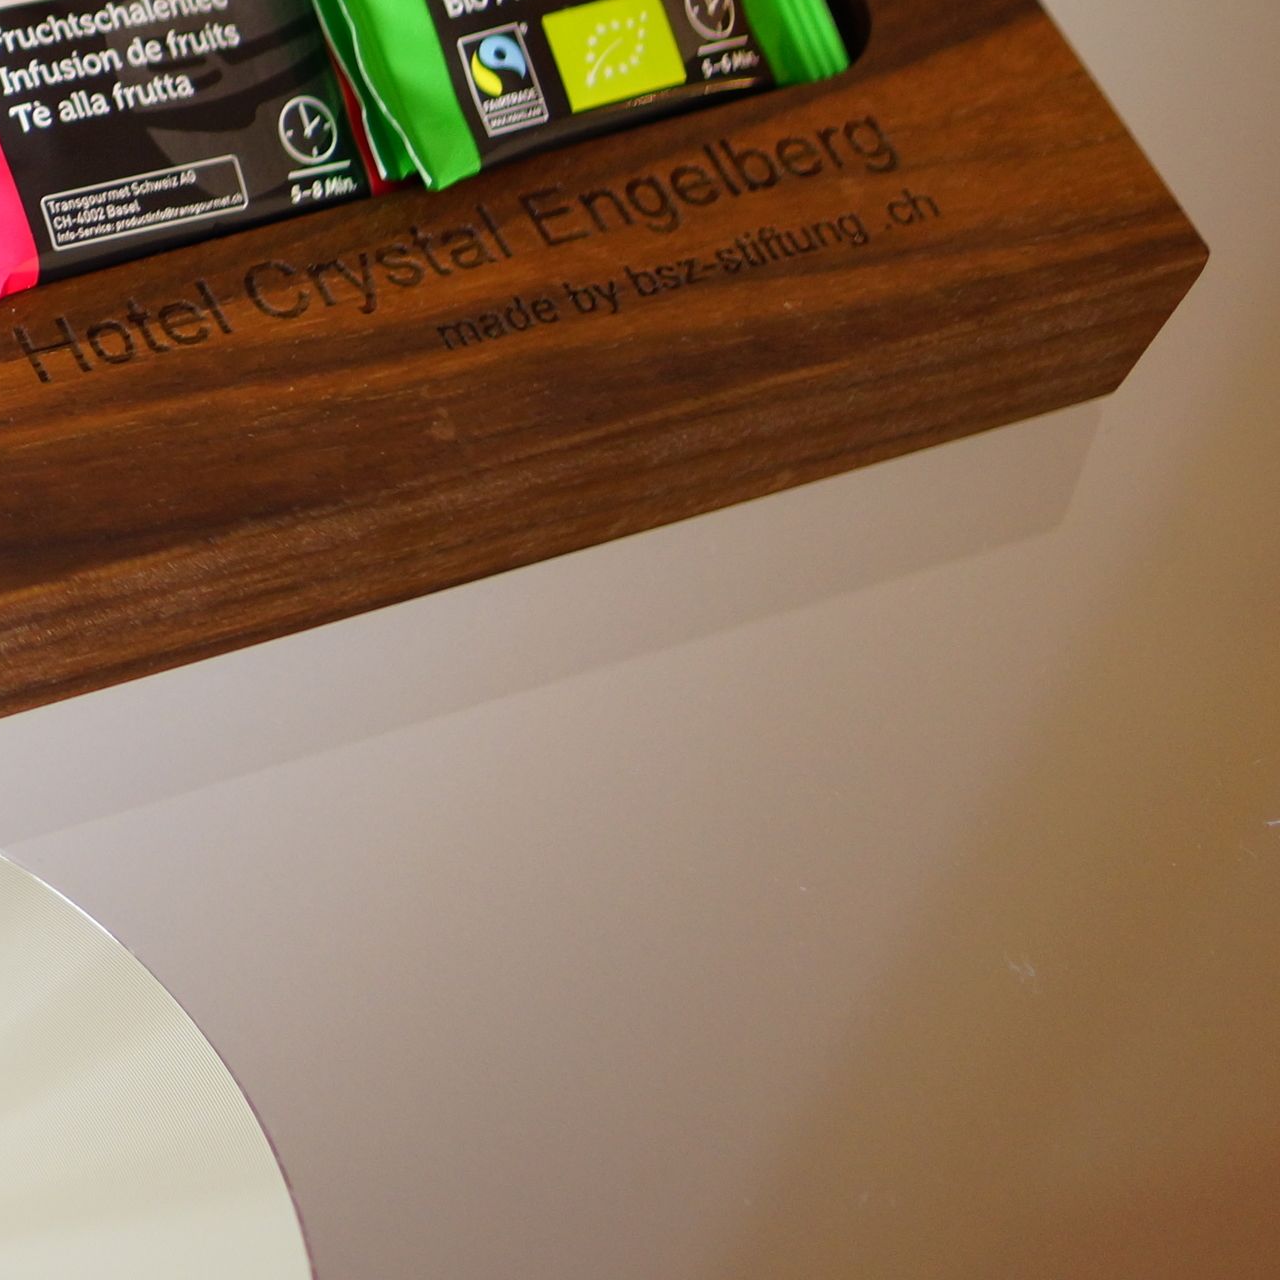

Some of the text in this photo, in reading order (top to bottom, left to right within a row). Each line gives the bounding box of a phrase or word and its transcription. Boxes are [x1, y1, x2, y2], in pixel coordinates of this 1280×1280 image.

[128, 35, 162, 64] de
[166, 20, 241, 58] fruits
[9, 70, 195, 134] Tè alla frutta
[48, 169, 197, 213] Transgourmet Schweiz AG
[54, 199, 140, 230] CH-4002 Basel
[12, 110, 903, 385] Hotel Crystal Engelberg
[439, 291, 559, 351] made
[565, 273, 621, 317] by
